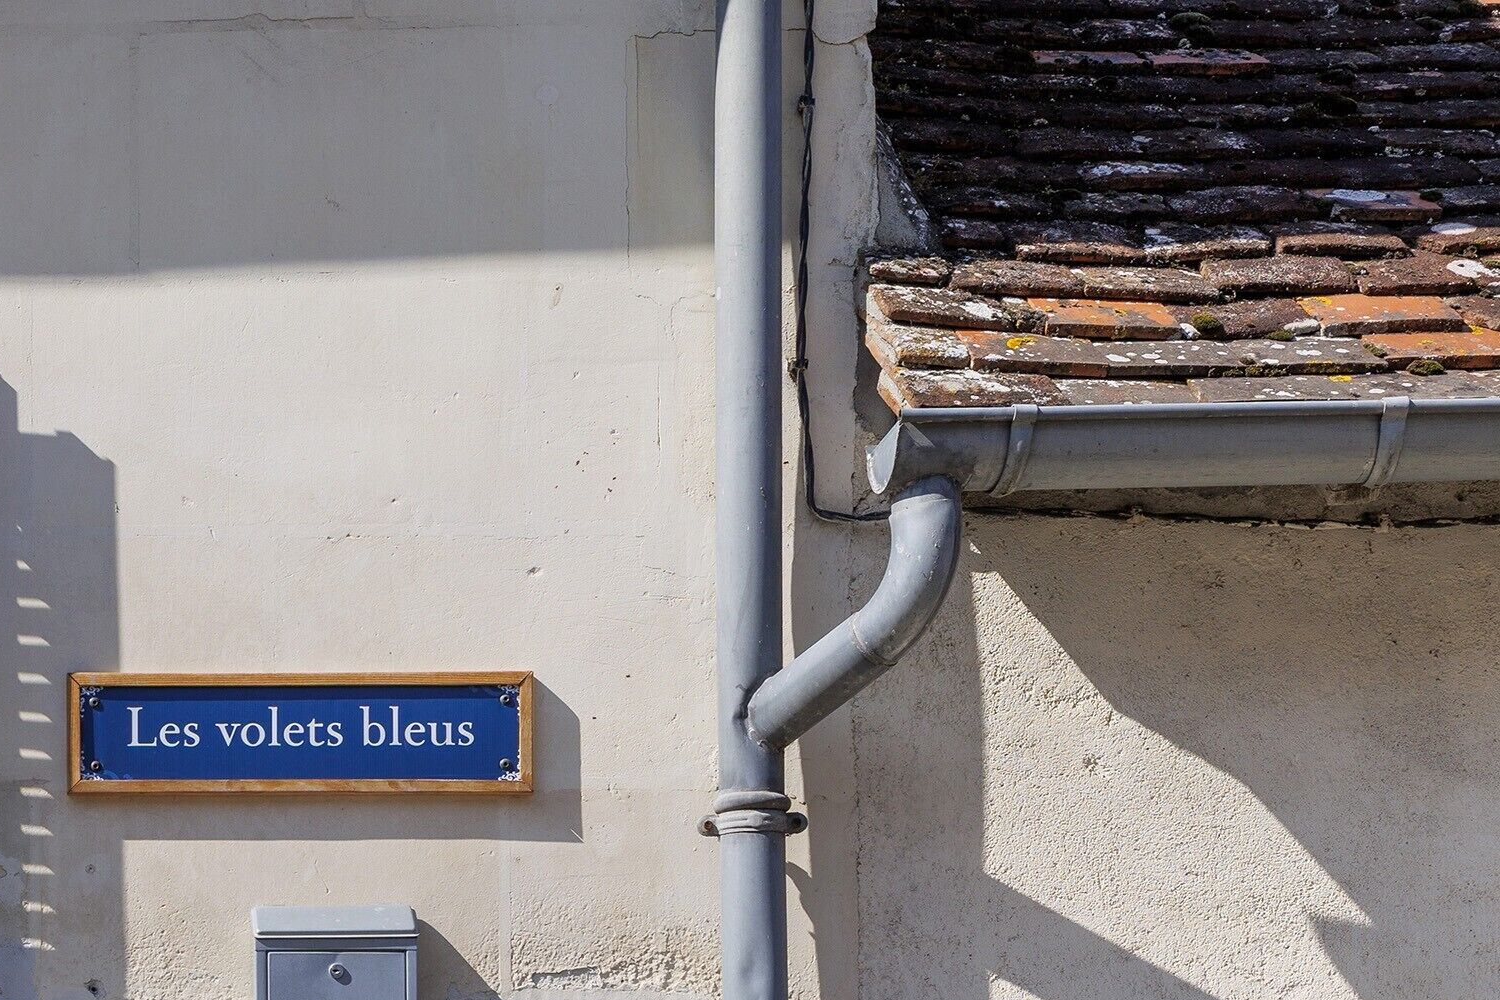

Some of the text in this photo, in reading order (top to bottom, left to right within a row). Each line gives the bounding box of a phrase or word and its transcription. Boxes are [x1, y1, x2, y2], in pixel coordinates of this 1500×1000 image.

[127, 705, 475, 747] Les volets bleus
